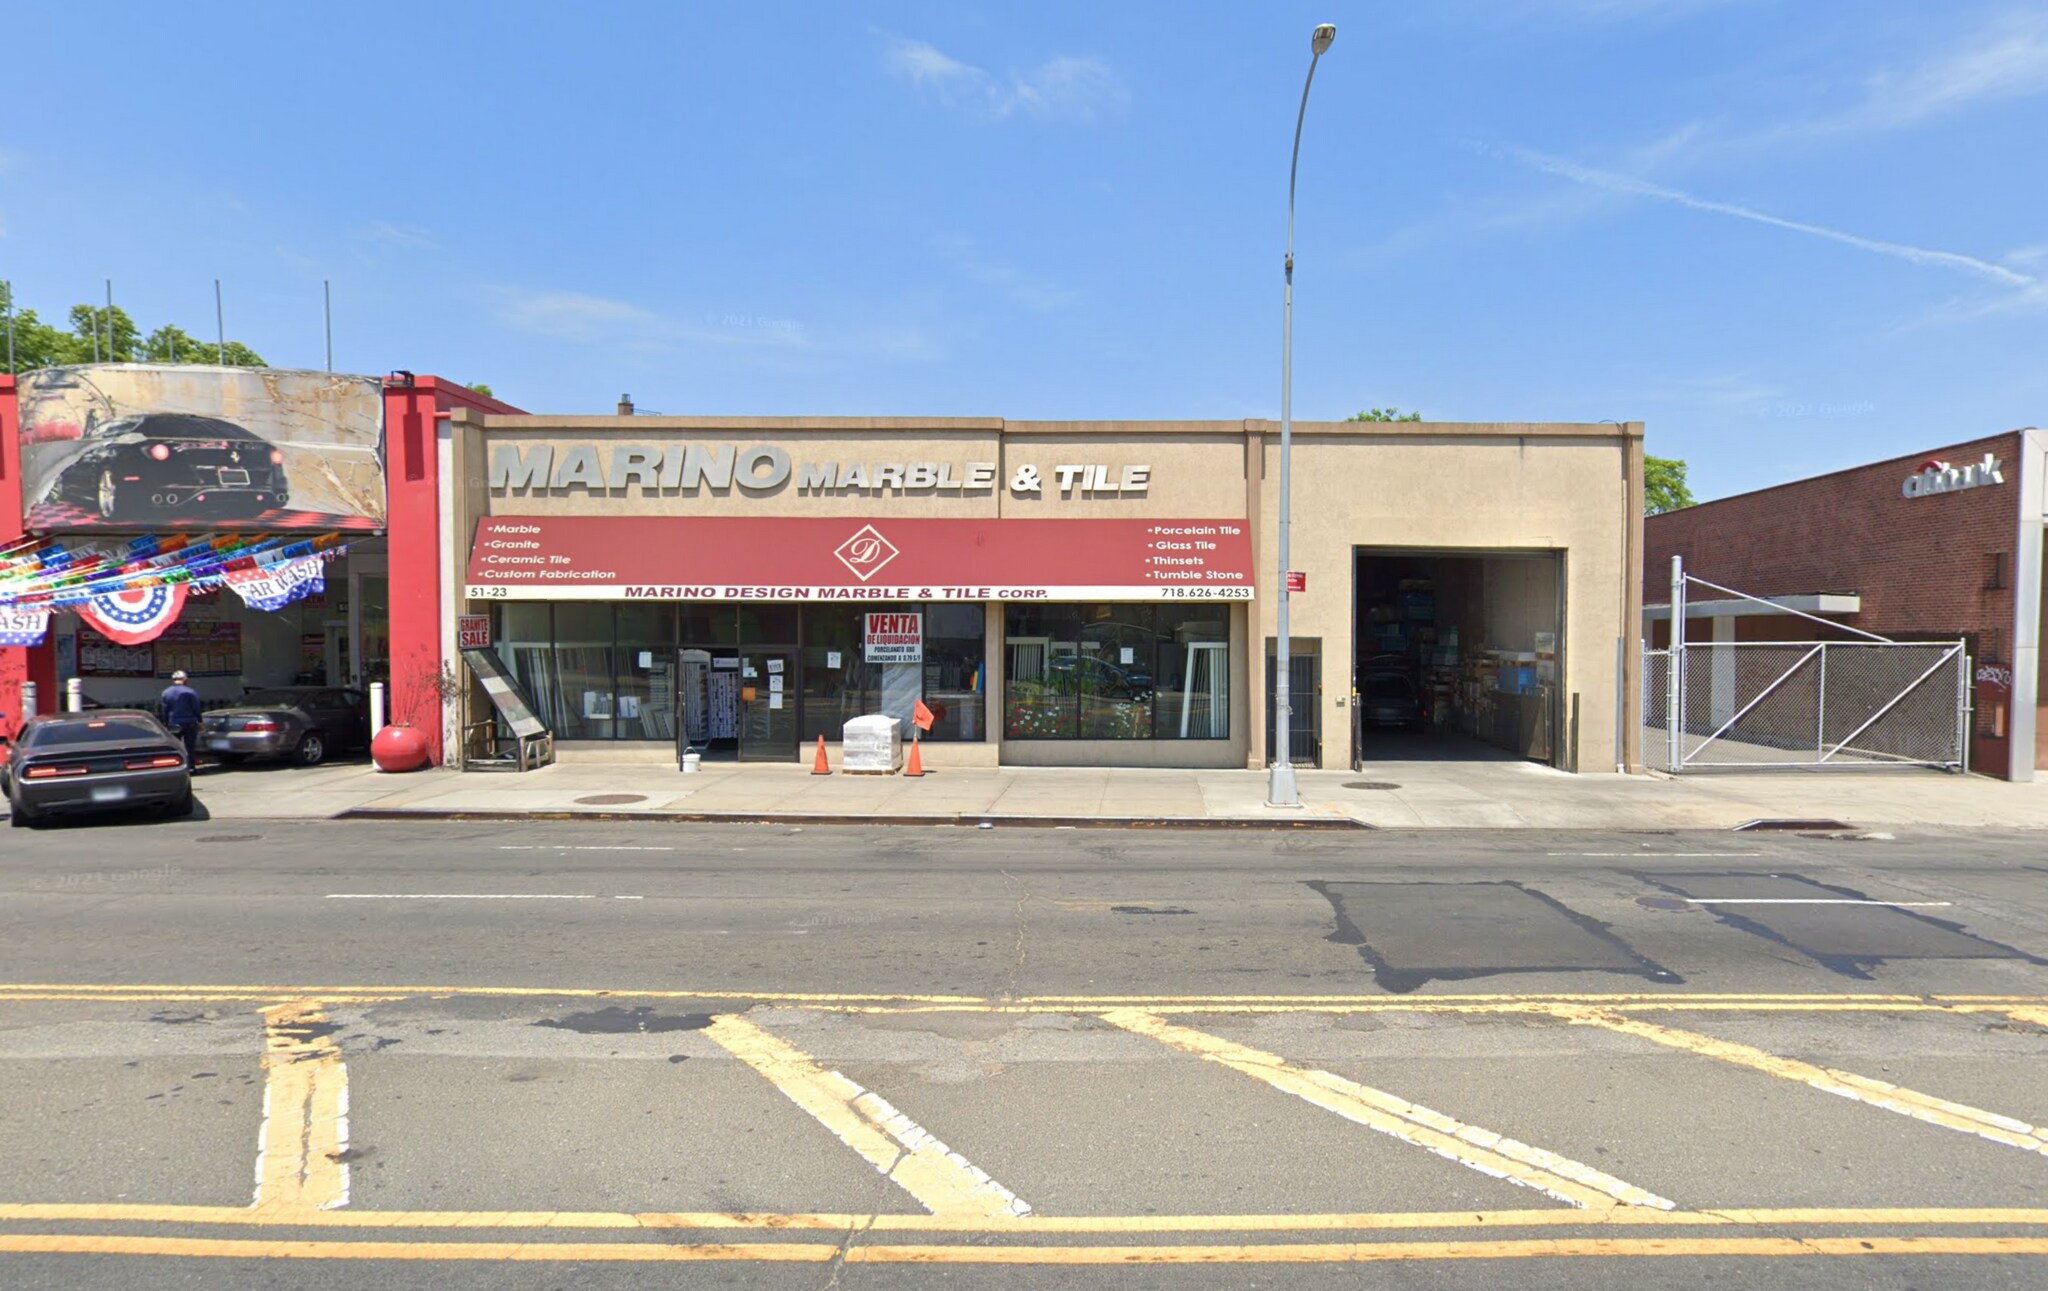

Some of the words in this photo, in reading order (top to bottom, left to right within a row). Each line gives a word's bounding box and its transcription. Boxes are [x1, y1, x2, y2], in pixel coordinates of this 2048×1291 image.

[492, 445, 791, 489] MARINO
[799, 462, 997, 489] MARBLE
[1010, 464, 1042, 492] &
[1055, 465, 1151, 491] TILE
[494, 525, 541, 534] Marble
[1154, 526, 1216, 535] Porcelain
[1219, 526, 1241, 535] Tile
[490, 540, 540, 549] Granite
[1156, 541, 1192, 550] Glass
[1195, 541, 1217, 550] Tile
[488, 555, 545, 564] Ceramic
[549, 555, 571, 564] Tile
[1153, 556, 1205, 565] Thinsets
[275, 559, 321, 592] WASH
[484, 569, 535, 579] Custom
[539, 569, 616, 579] Fabrication
[1153, 570, 1203, 579] Tumble
[1205, 570, 1244, 579] Stone
[470, 587, 507, 597] 51-23
[624, 586, 717, 598] MARINO
[724, 587, 810, 599] DESIGN
[817, 588, 910, 599] MARBLE
[917, 588, 933, 599] &
[942, 588, 991, 599] TILE
[998, 589, 1048, 599] CORP.
[1161, 588, 1250, 598] 718.626-4253
[460, 618, 488, 631] GRANITE
[868, 614, 919, 634] VENTA
[461, 631, 488, 646] SALE
[867, 634, 876, 644] DE
[877, 634, 920, 645] LIQUIDACION
